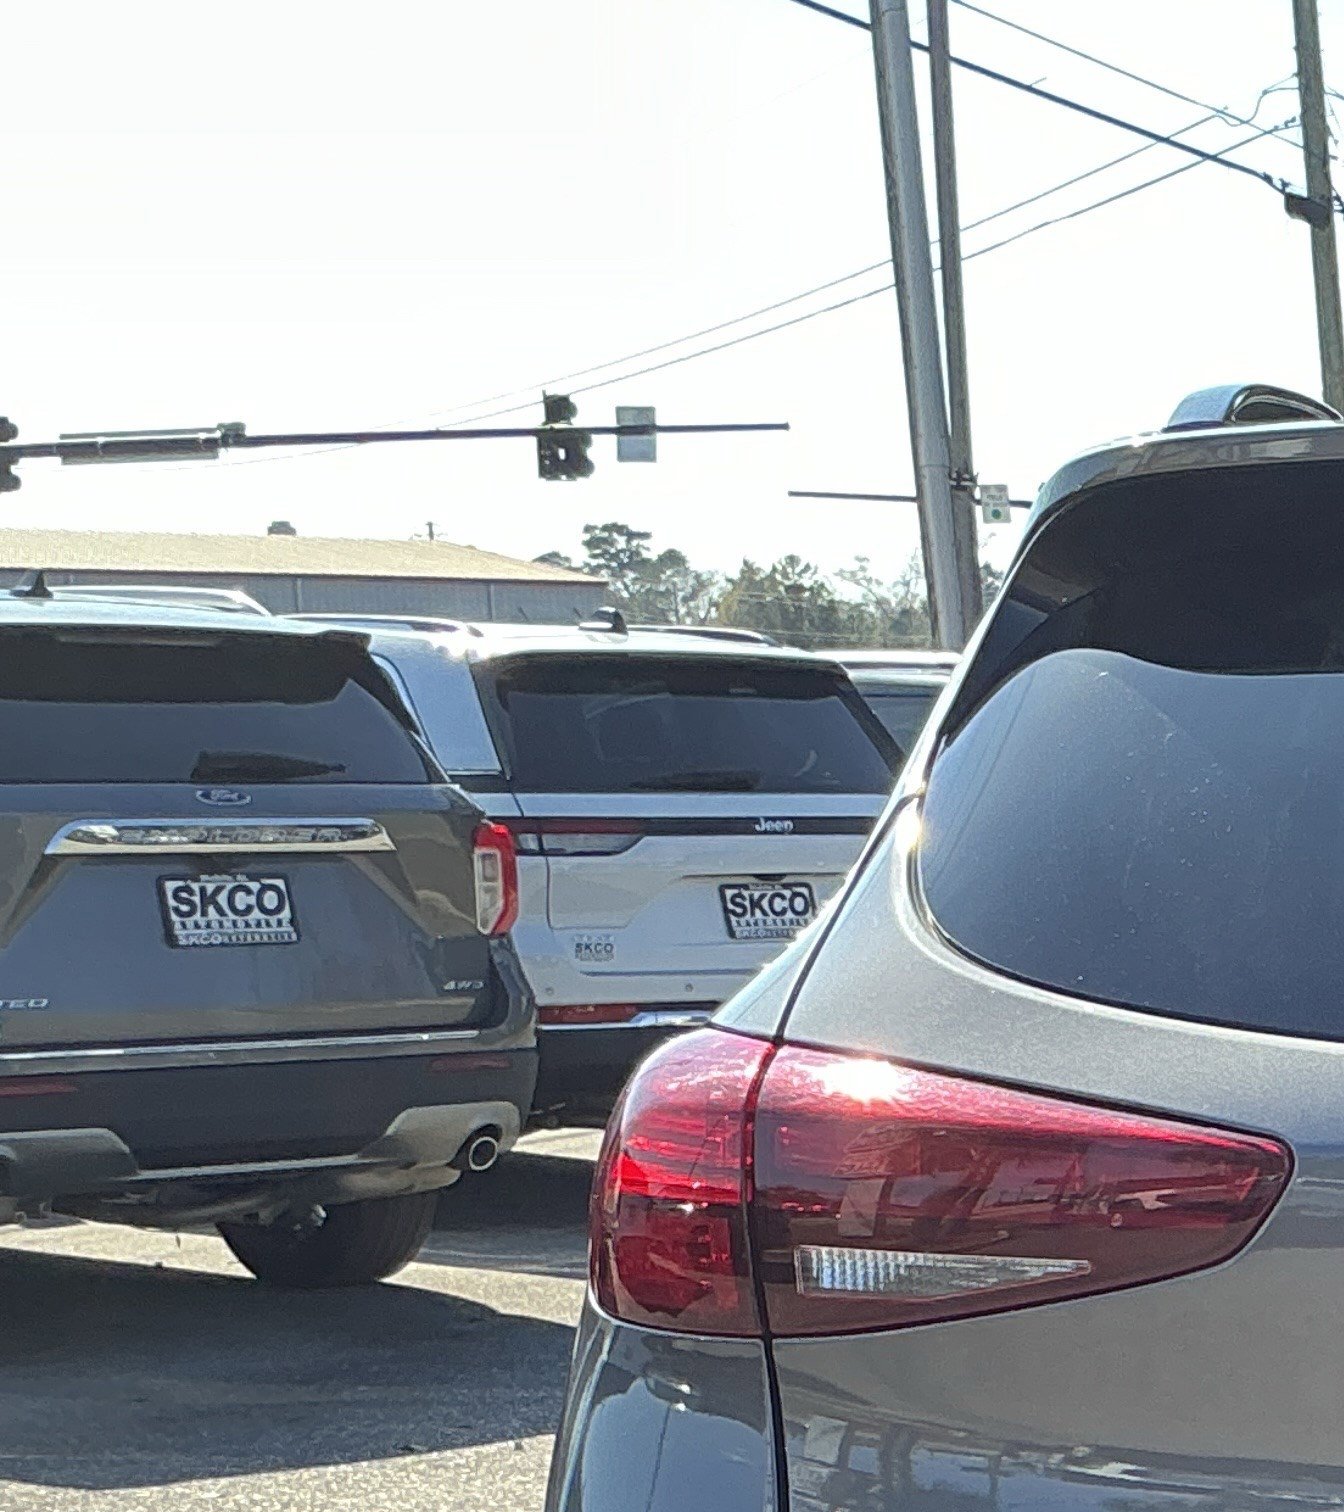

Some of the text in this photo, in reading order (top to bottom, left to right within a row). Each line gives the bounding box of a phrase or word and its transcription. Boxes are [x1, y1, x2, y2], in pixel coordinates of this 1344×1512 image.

[171, 883, 286, 918] SKCO
[727, 891, 810, 918] SKCO
[574, 942, 614, 954] SKCO
